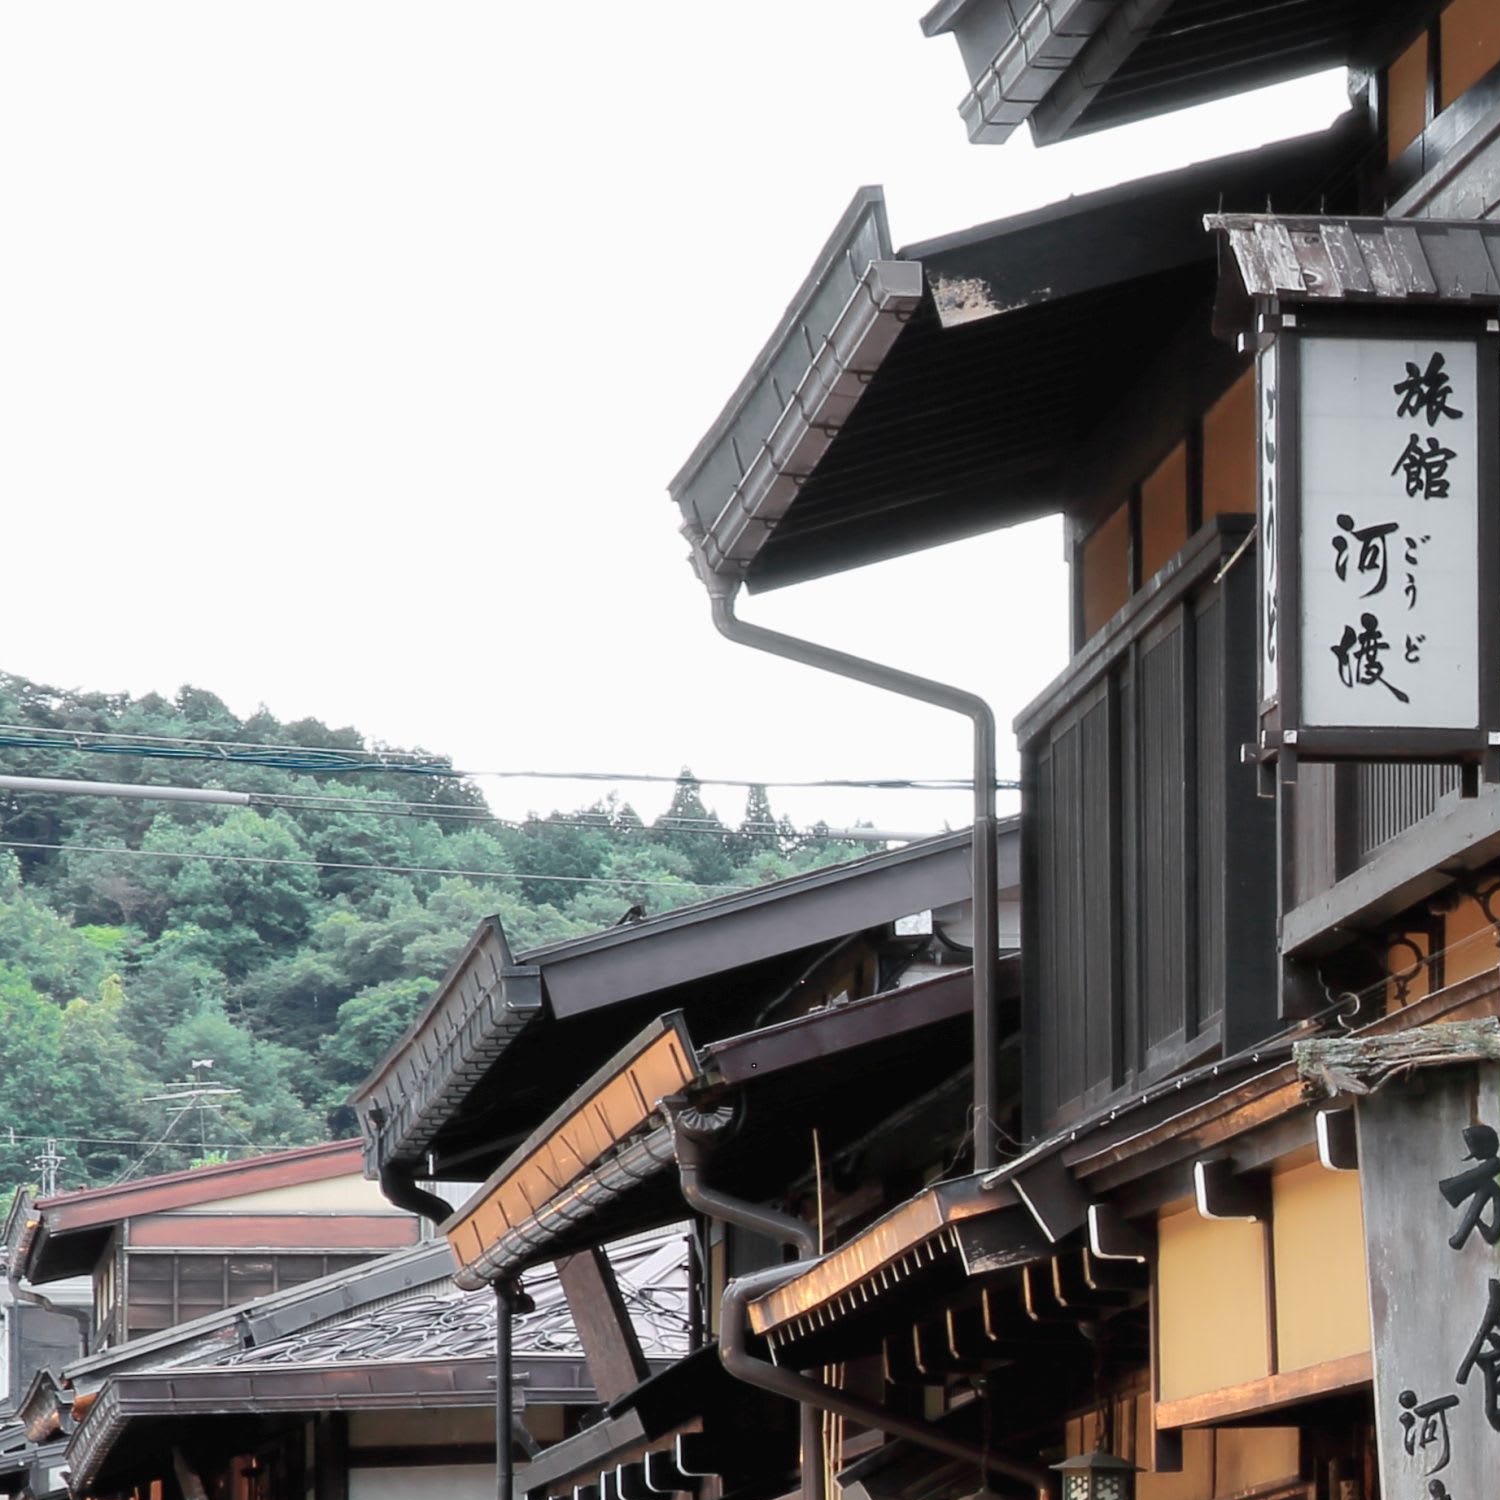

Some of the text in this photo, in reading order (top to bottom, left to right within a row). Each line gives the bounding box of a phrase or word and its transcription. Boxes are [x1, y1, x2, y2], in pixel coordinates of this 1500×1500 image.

[1391, 352, 1463, 500] 旅館
[1404, 533, 1432, 666] ごうど
